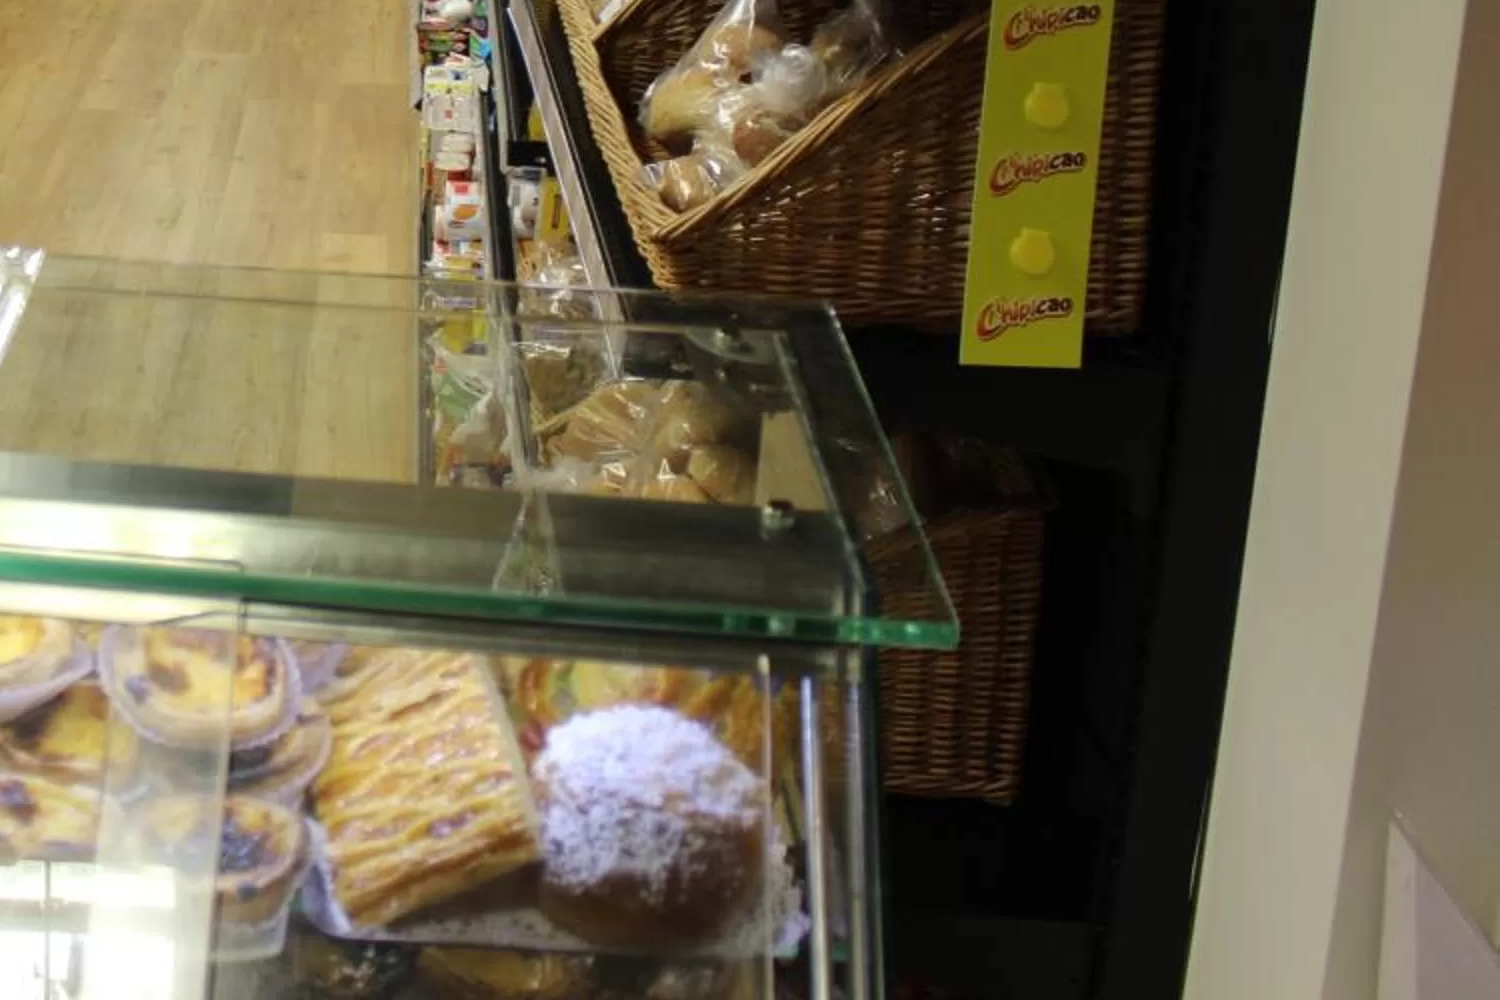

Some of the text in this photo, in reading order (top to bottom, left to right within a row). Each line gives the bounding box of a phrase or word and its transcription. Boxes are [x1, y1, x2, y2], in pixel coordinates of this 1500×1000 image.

[1003, 3, 1101, 50] Chipicao
[989, 151, 1087, 196] Chipicao
[976, 296, 1073, 341] Chipicao
